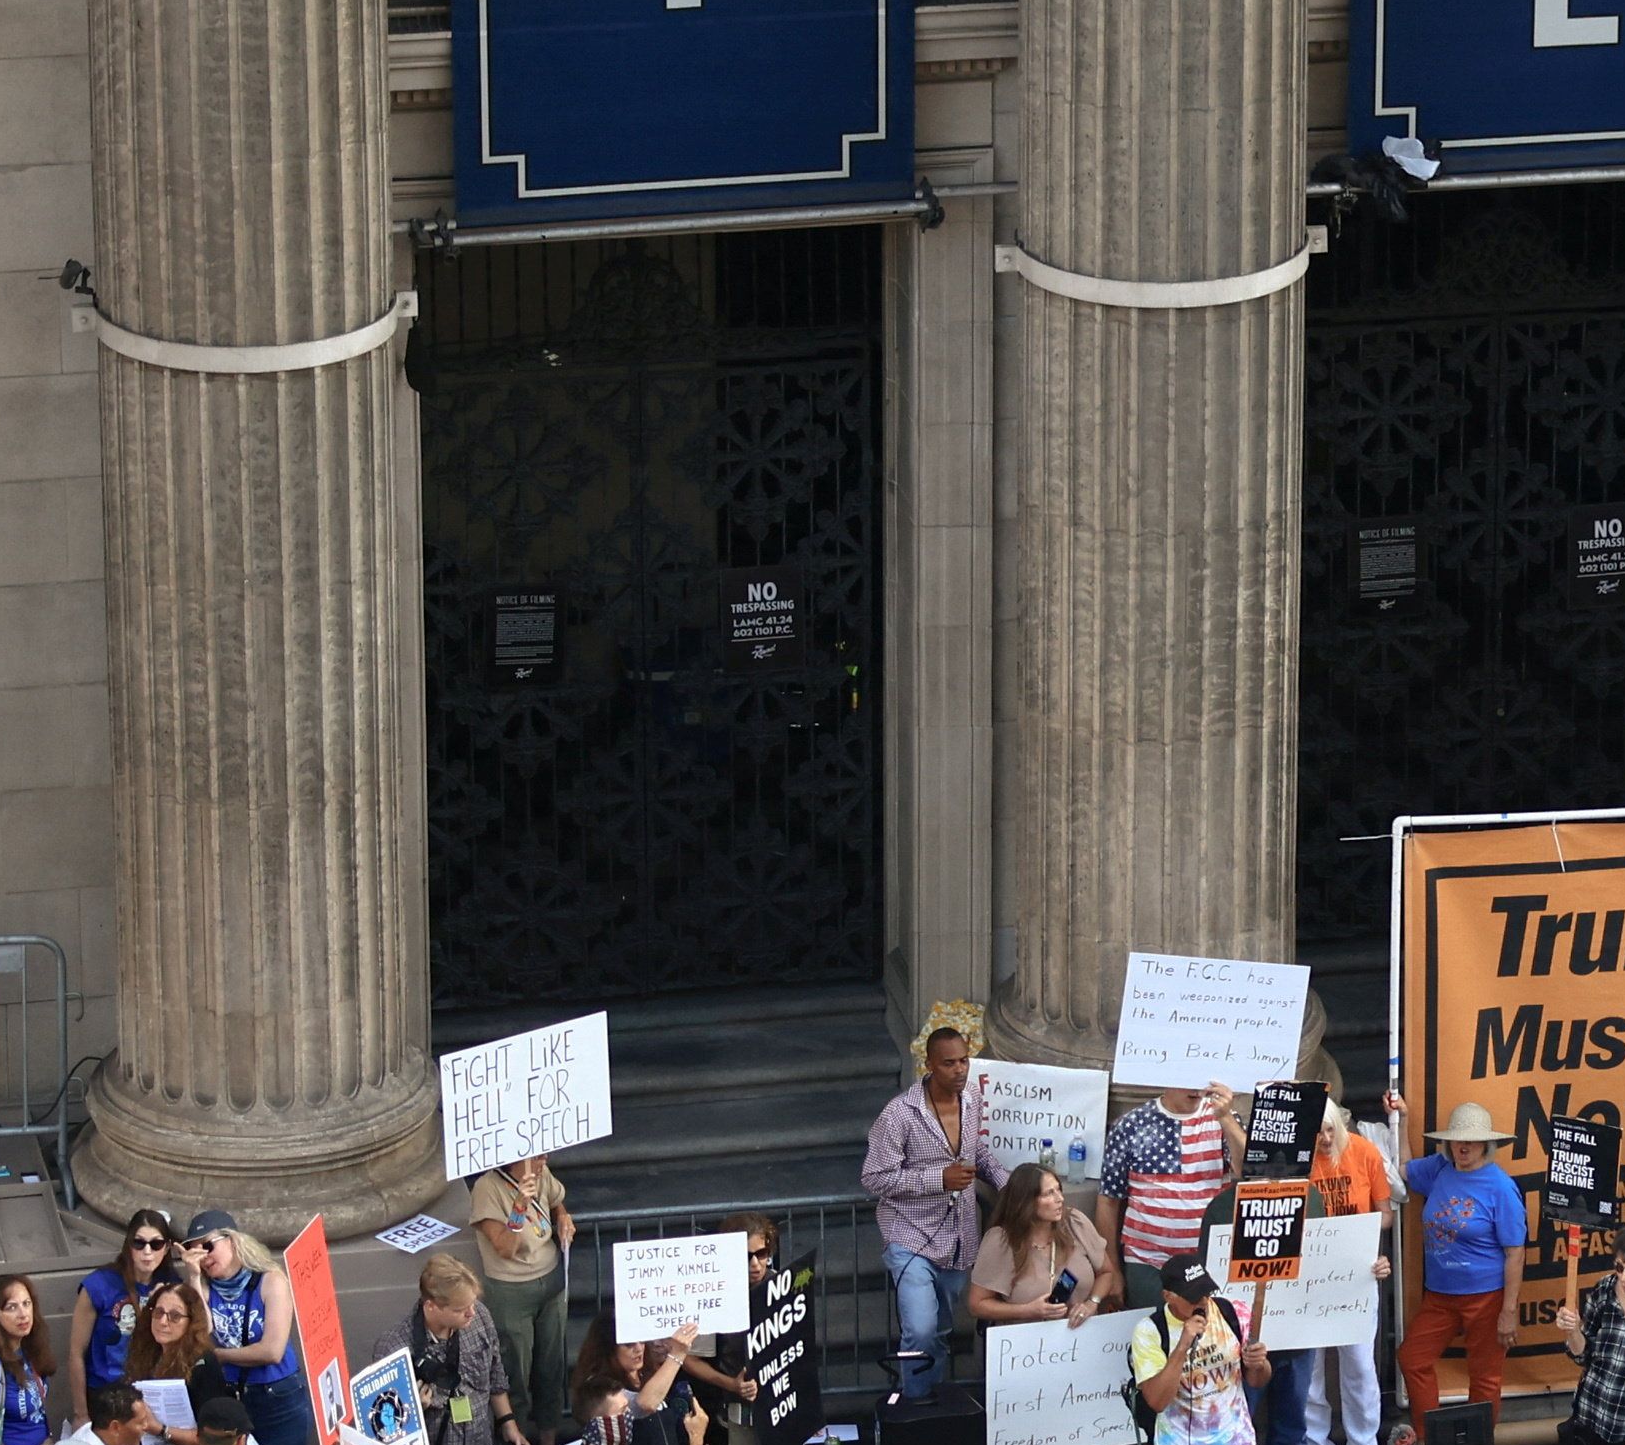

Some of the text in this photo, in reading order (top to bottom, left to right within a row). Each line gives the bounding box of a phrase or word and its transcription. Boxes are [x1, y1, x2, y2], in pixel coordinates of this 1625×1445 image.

[748, 582, 777, 601] NO
[731, 600, 795, 614] TRESPASSING
[733, 615, 793, 628] LAMC 41.24
[733, 627, 753, 637] 602
[1141, 960, 1175, 976] The
[1247, 968, 1274, 985] has
[1133, 986, 1165, 1000] been
[1180, 993, 1248, 1004] weaponized
[1132, 1008, 1155, 1020] the
[1168, 1010, 1226, 1024] American
[1122, 1041, 1293, 1079] Bring Back Jimmy
[528, 1069, 570, 1113] FOR
[455, 1102, 590, 1176] FREE SPEECH
[1240, 1197, 1303, 1218] TRUMP
[1243, 1218, 1294, 1237] MUST
[625, 1244, 717, 1261] JUSTICE FOR
[1255, 1239, 1279, 1257] GO
[628, 1262, 720, 1280] JIMMY KIMMEL
[1238, 1260, 1292, 1278] NOW!
[628, 1280, 726, 1300] WE THE PEOPLE
[766, 1269, 792, 1307] NO
[640, 1298, 723, 1317] DEMAND FREE
[654, 1314, 700, 1329] SPEECH
[746, 1293, 806, 1360] KINGS
[758, 1340, 804, 1386] UNLESS
[1000, 1338, 1132, 1376] Protect our
[772, 1372, 789, 1398] WE
[770, 1392, 797, 1427] BOW
[994, 1388, 1044, 1420] First
[1068, 1426, 1083, 1440] of
[1092, 1417, 1134, 1438] Speech
